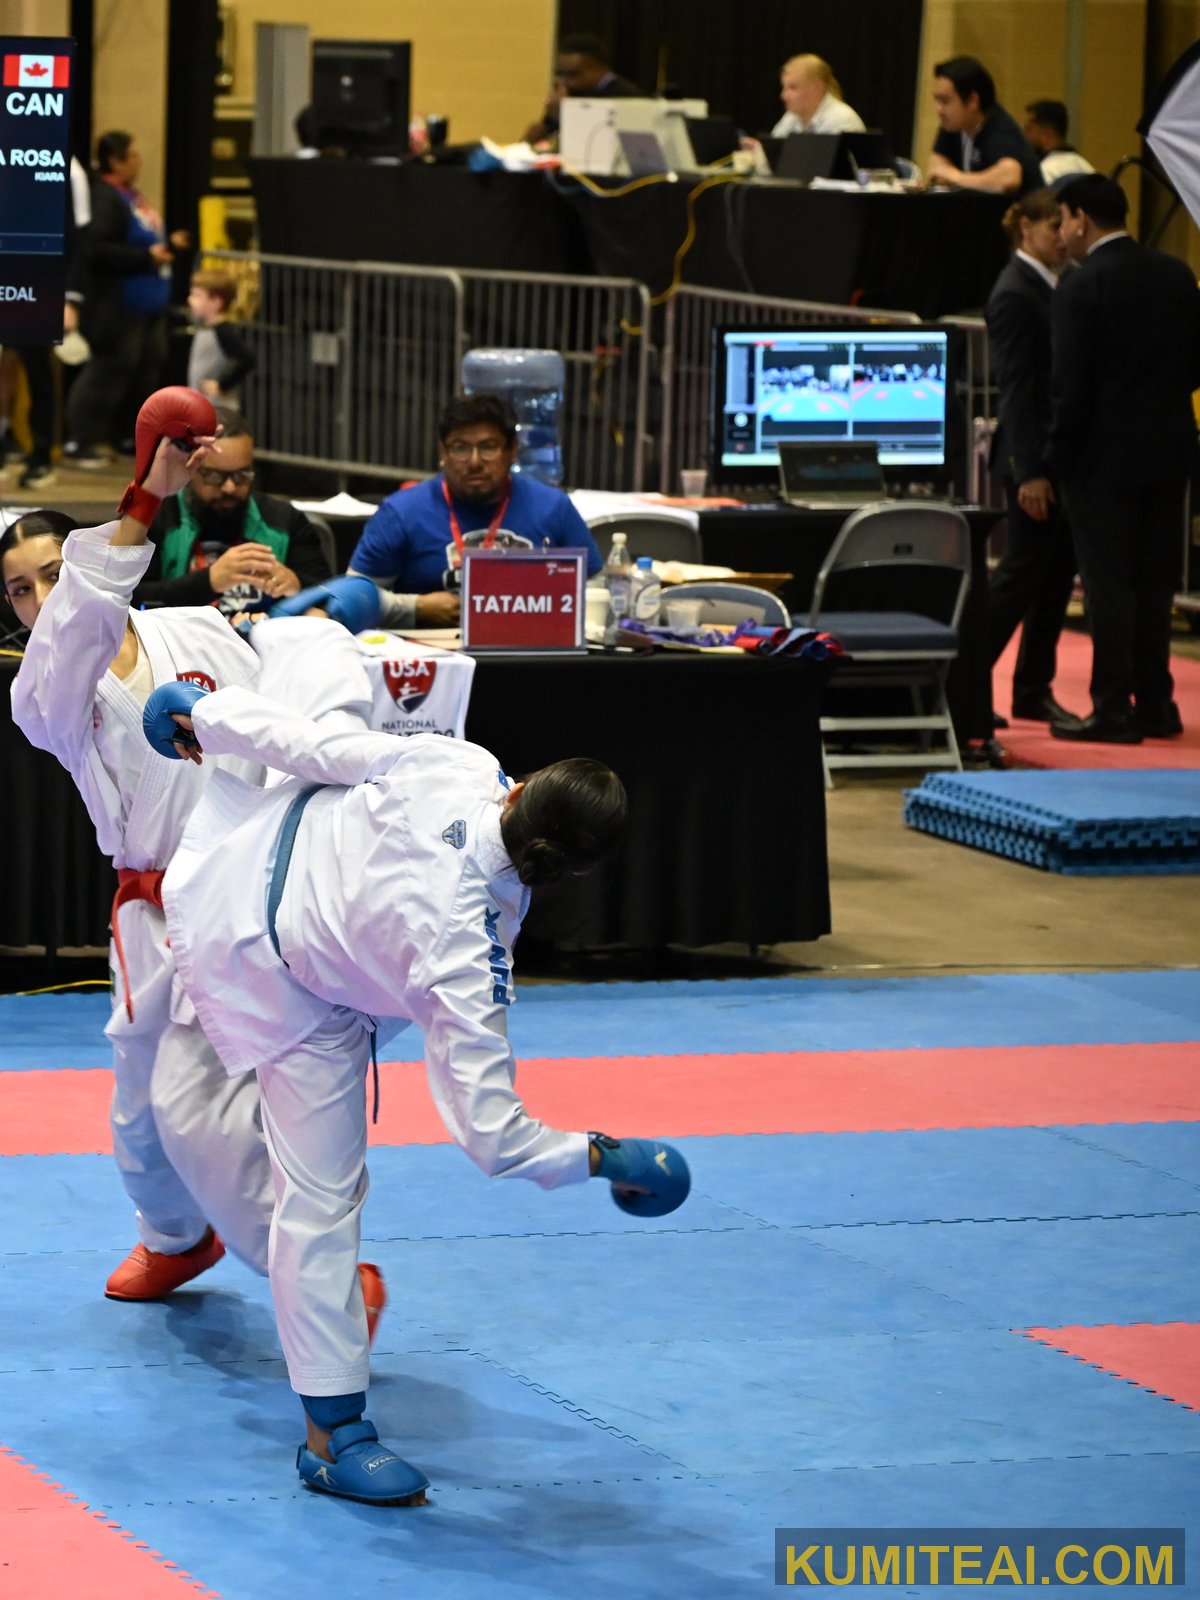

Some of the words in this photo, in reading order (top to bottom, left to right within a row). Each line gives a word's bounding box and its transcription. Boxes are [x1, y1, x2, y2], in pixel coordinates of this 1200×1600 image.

[6, 92, 64, 116] CAN
[10, 149, 66, 168] ROSA
[34, 172, 66, 182] KIARA
[472, 595, 553, 613] TATAMI
[560, 594, 573, 613] 2
[388, 659, 431, 678] USA
[382, 720, 438, 731] NATIONAL
